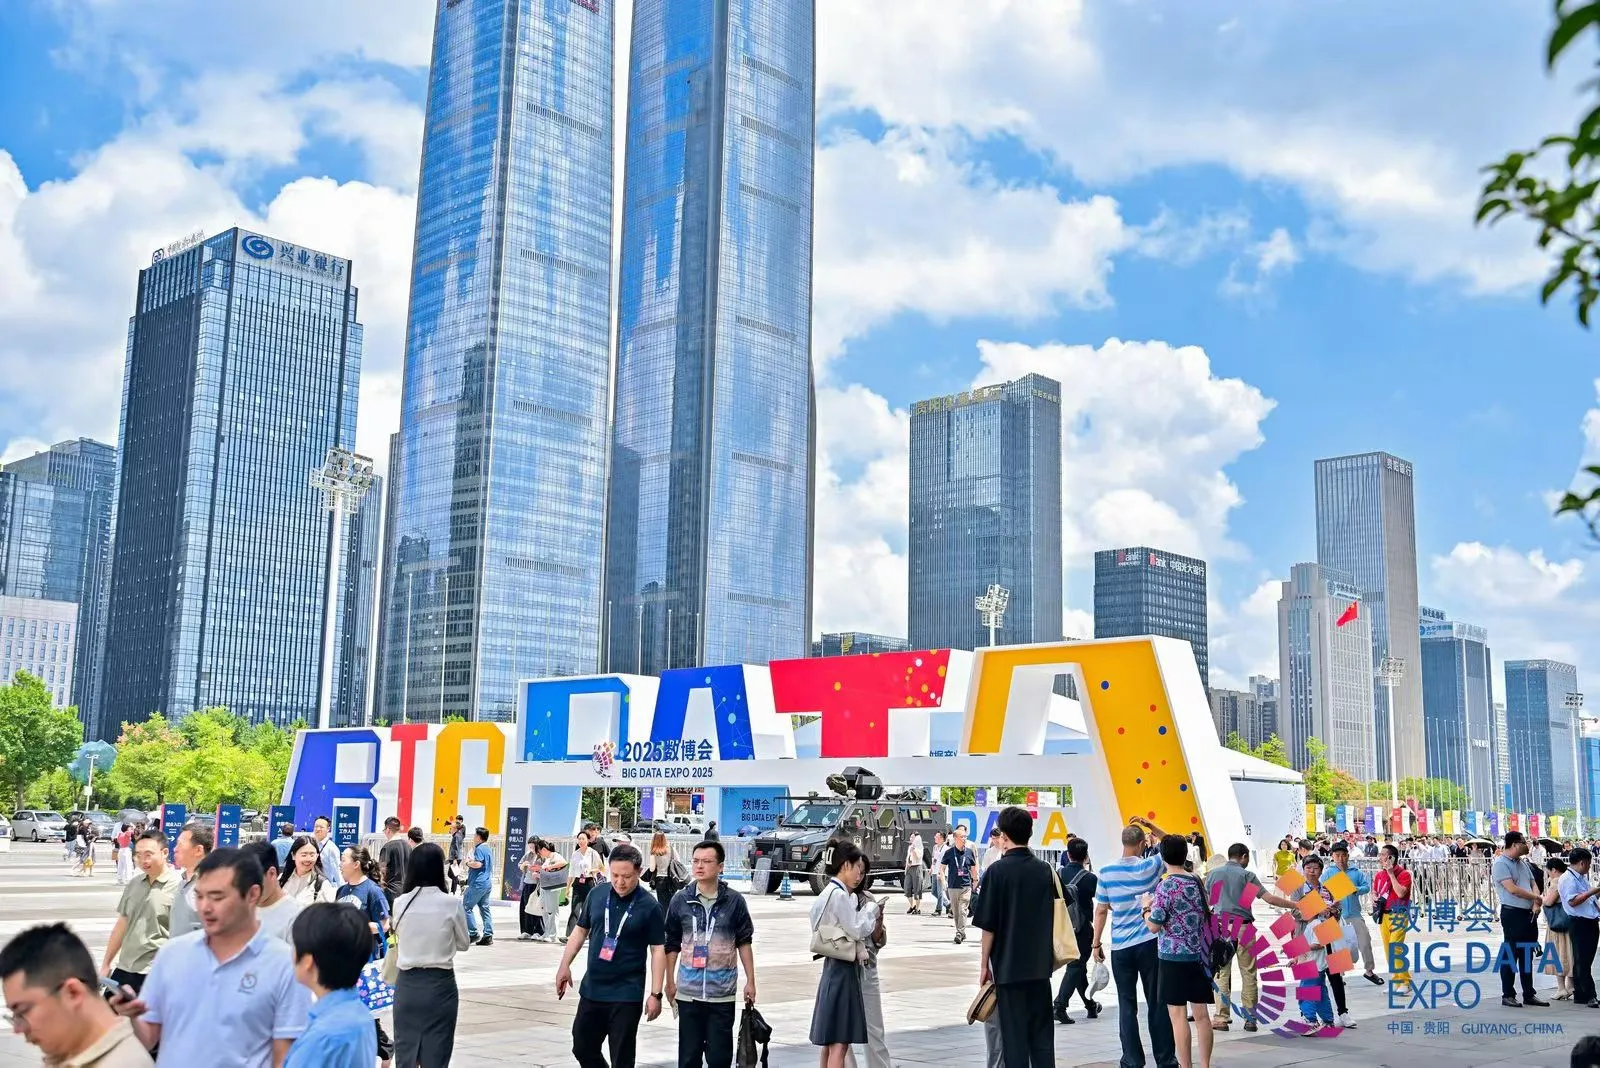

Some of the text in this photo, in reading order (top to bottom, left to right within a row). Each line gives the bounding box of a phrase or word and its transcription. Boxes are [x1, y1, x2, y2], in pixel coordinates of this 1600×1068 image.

[279, 244, 345, 276] 兴业银行
[1169, 560, 1205, 576] 中国光大银行
[520, 637, 1214, 858] DATA
[622, 739, 713, 762] 2025数博会
[621, 767, 713, 778] BIG DATA EXPO 2025
[741, 799, 770, 811] 数博会
[741, 814, 780, 822] BIG DATA EXP
[951, 810, 1070, 847] DAA
[880, 835, 893, 844] 特警
